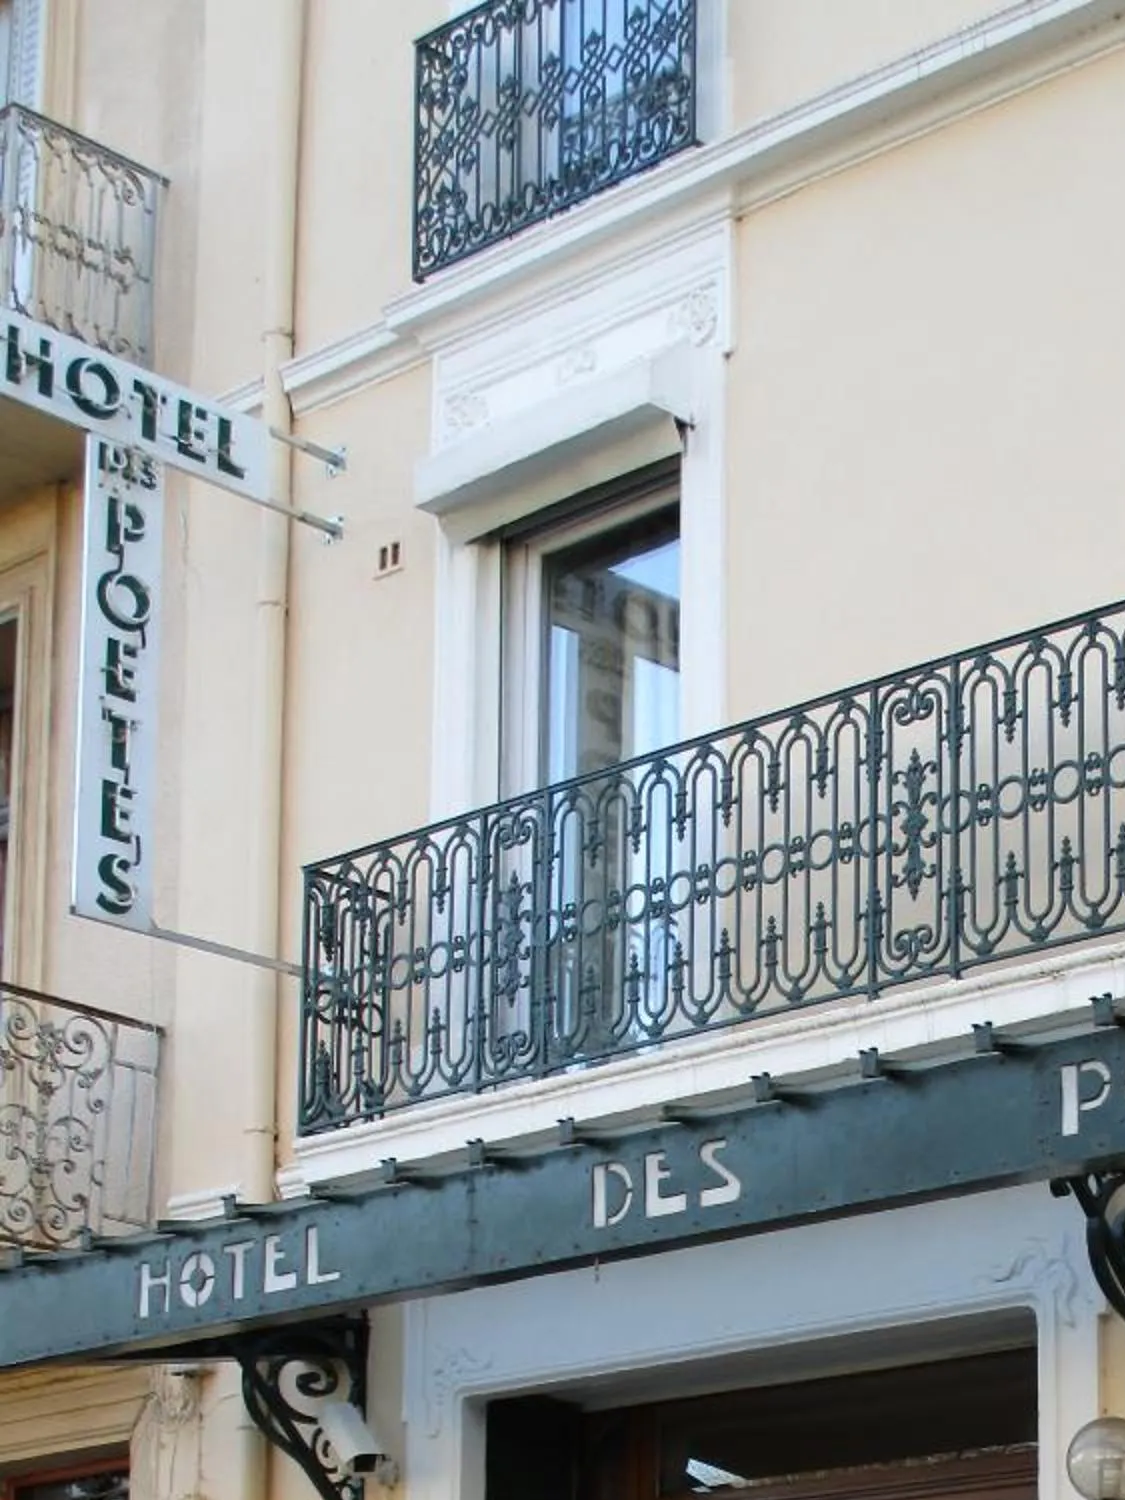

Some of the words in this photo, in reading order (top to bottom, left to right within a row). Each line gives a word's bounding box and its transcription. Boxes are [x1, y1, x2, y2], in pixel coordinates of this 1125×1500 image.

[6, 325, 246, 479] HOTEL
[96, 496, 150, 914] POETES
[139, 1227, 341, 1318] HOTEL
[592, 1140, 741, 1228] DES
